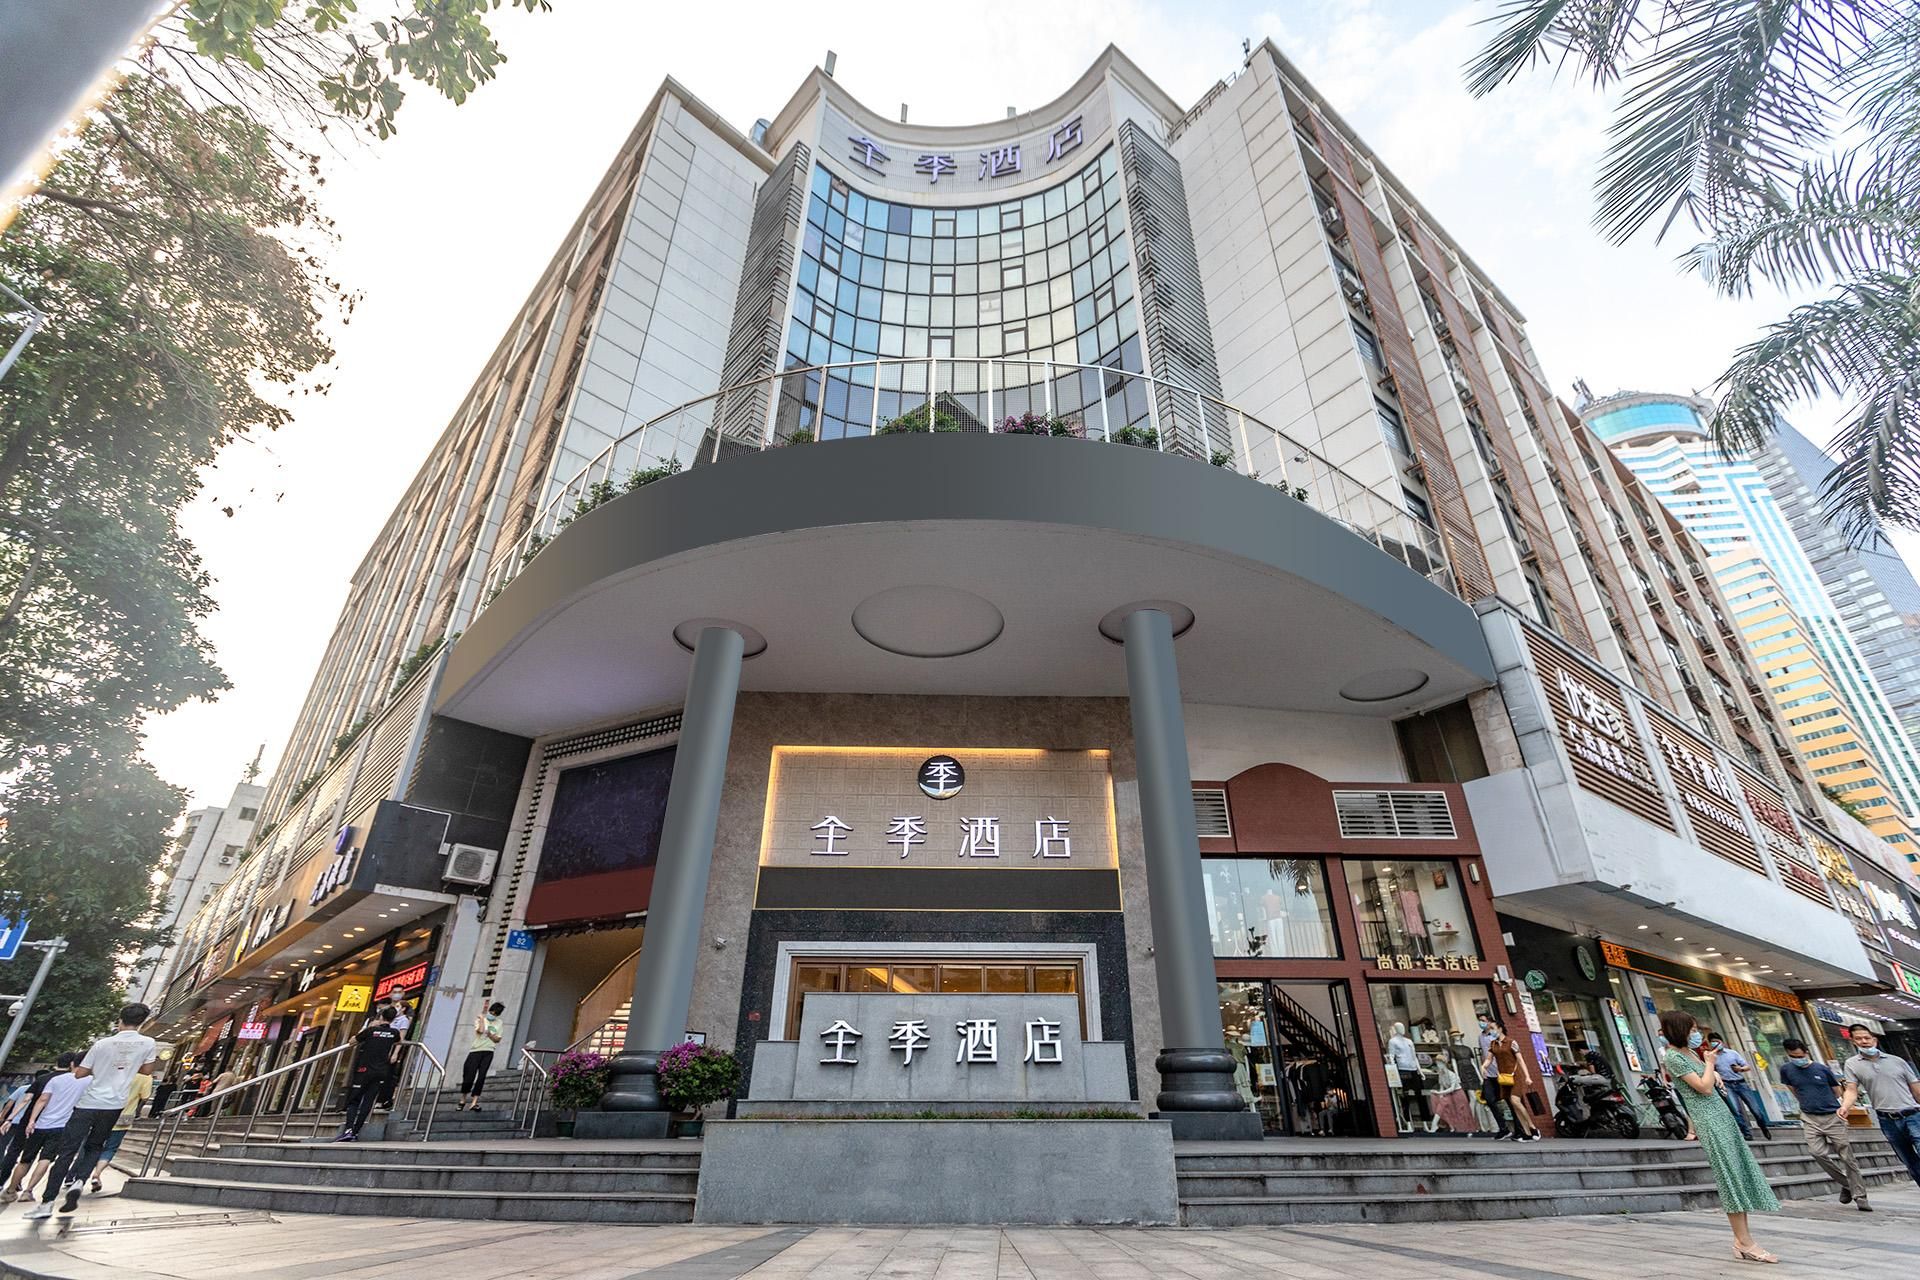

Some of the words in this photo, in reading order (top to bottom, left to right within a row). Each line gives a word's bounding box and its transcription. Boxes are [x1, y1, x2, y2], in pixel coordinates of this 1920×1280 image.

[848, 115, 1083, 184] 全季酒店
[925, 761, 959, 794] 季
[1660, 732, 1736, 803] 全季酒店
[811, 815, 1072, 859] 全季酒店
[819, 1017, 1064, 1067] 全季酒店
